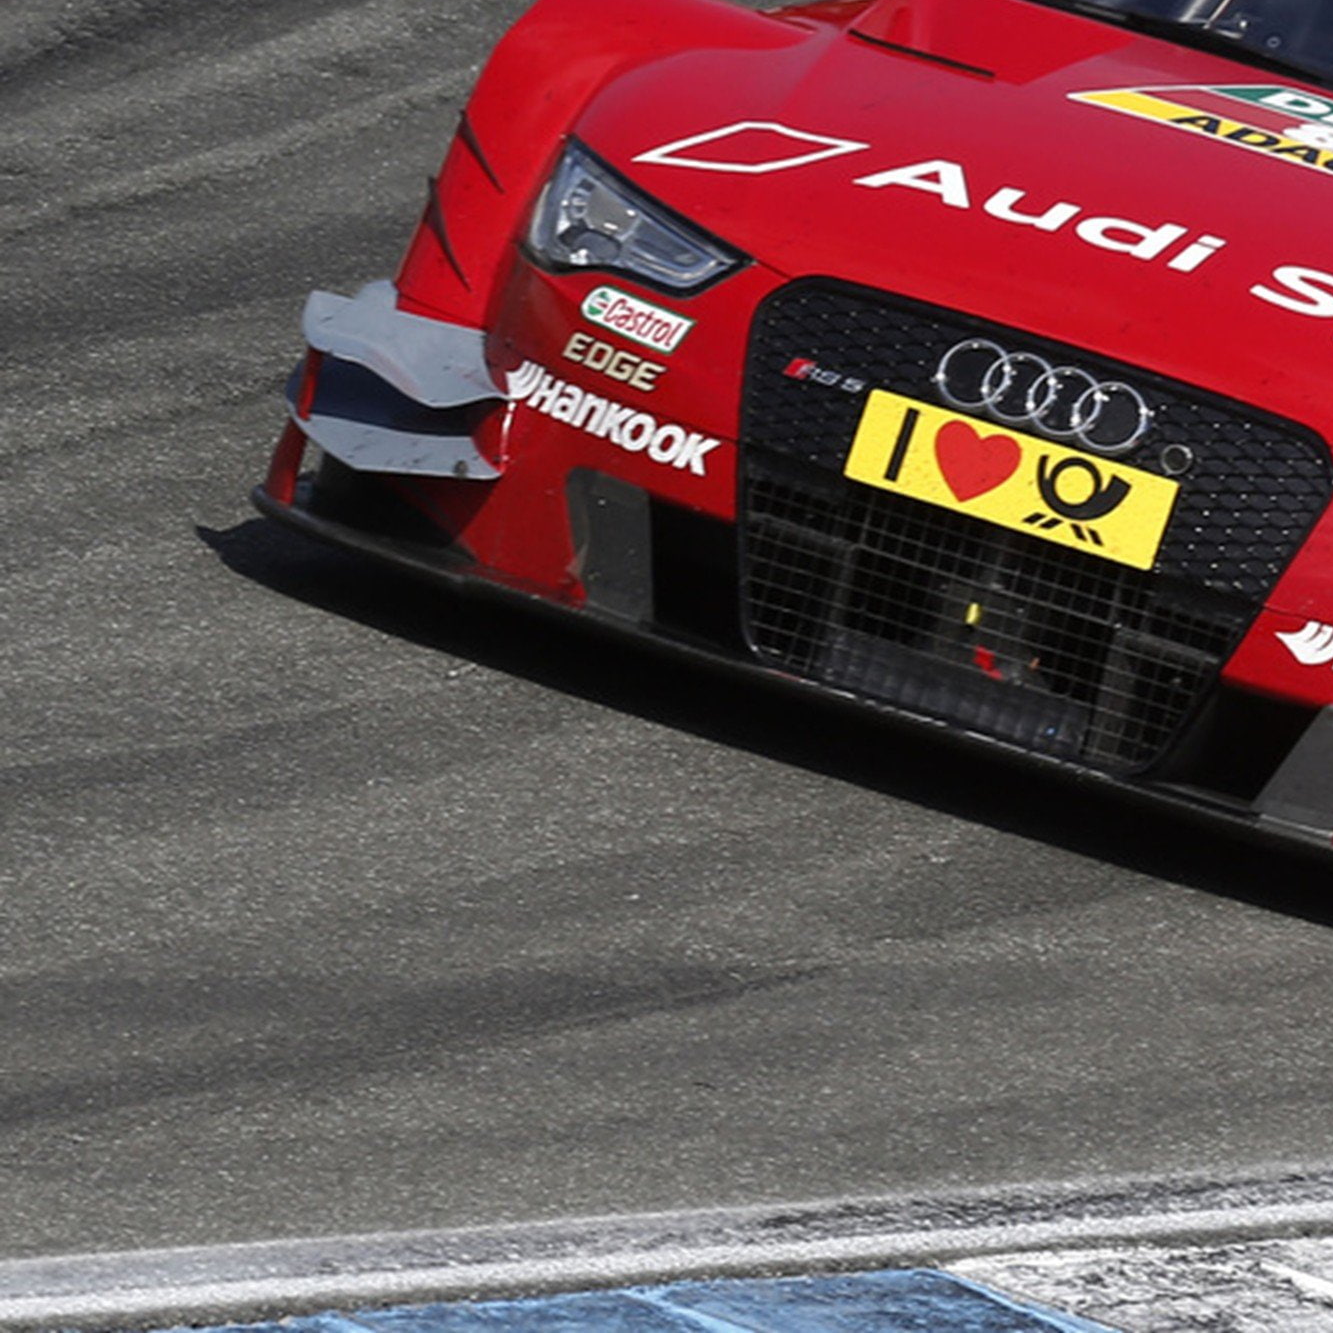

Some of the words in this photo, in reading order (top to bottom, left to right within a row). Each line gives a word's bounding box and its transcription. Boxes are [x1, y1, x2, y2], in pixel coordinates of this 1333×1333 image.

[852, 160, 1227, 273] Audi
[602, 296, 685, 348] Castrol
[561, 331, 667, 392] EDGE
